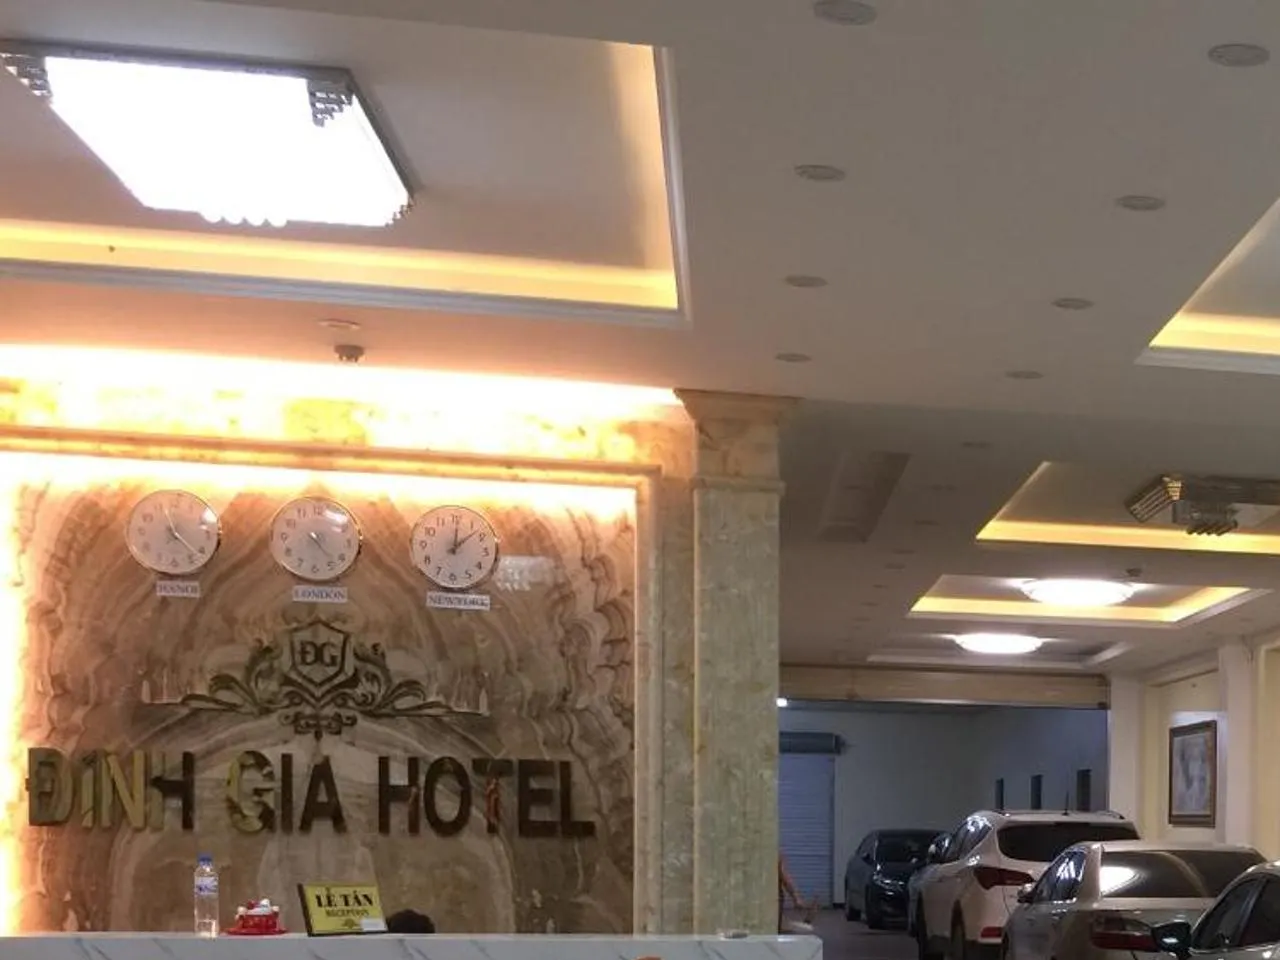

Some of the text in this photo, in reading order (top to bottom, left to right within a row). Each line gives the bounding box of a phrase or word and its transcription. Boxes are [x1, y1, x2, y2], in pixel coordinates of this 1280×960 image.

[294, 589, 346, 600] LONDON
[226, 749, 347, 835] GIA
[377, 755, 597, 838] HOTEL
